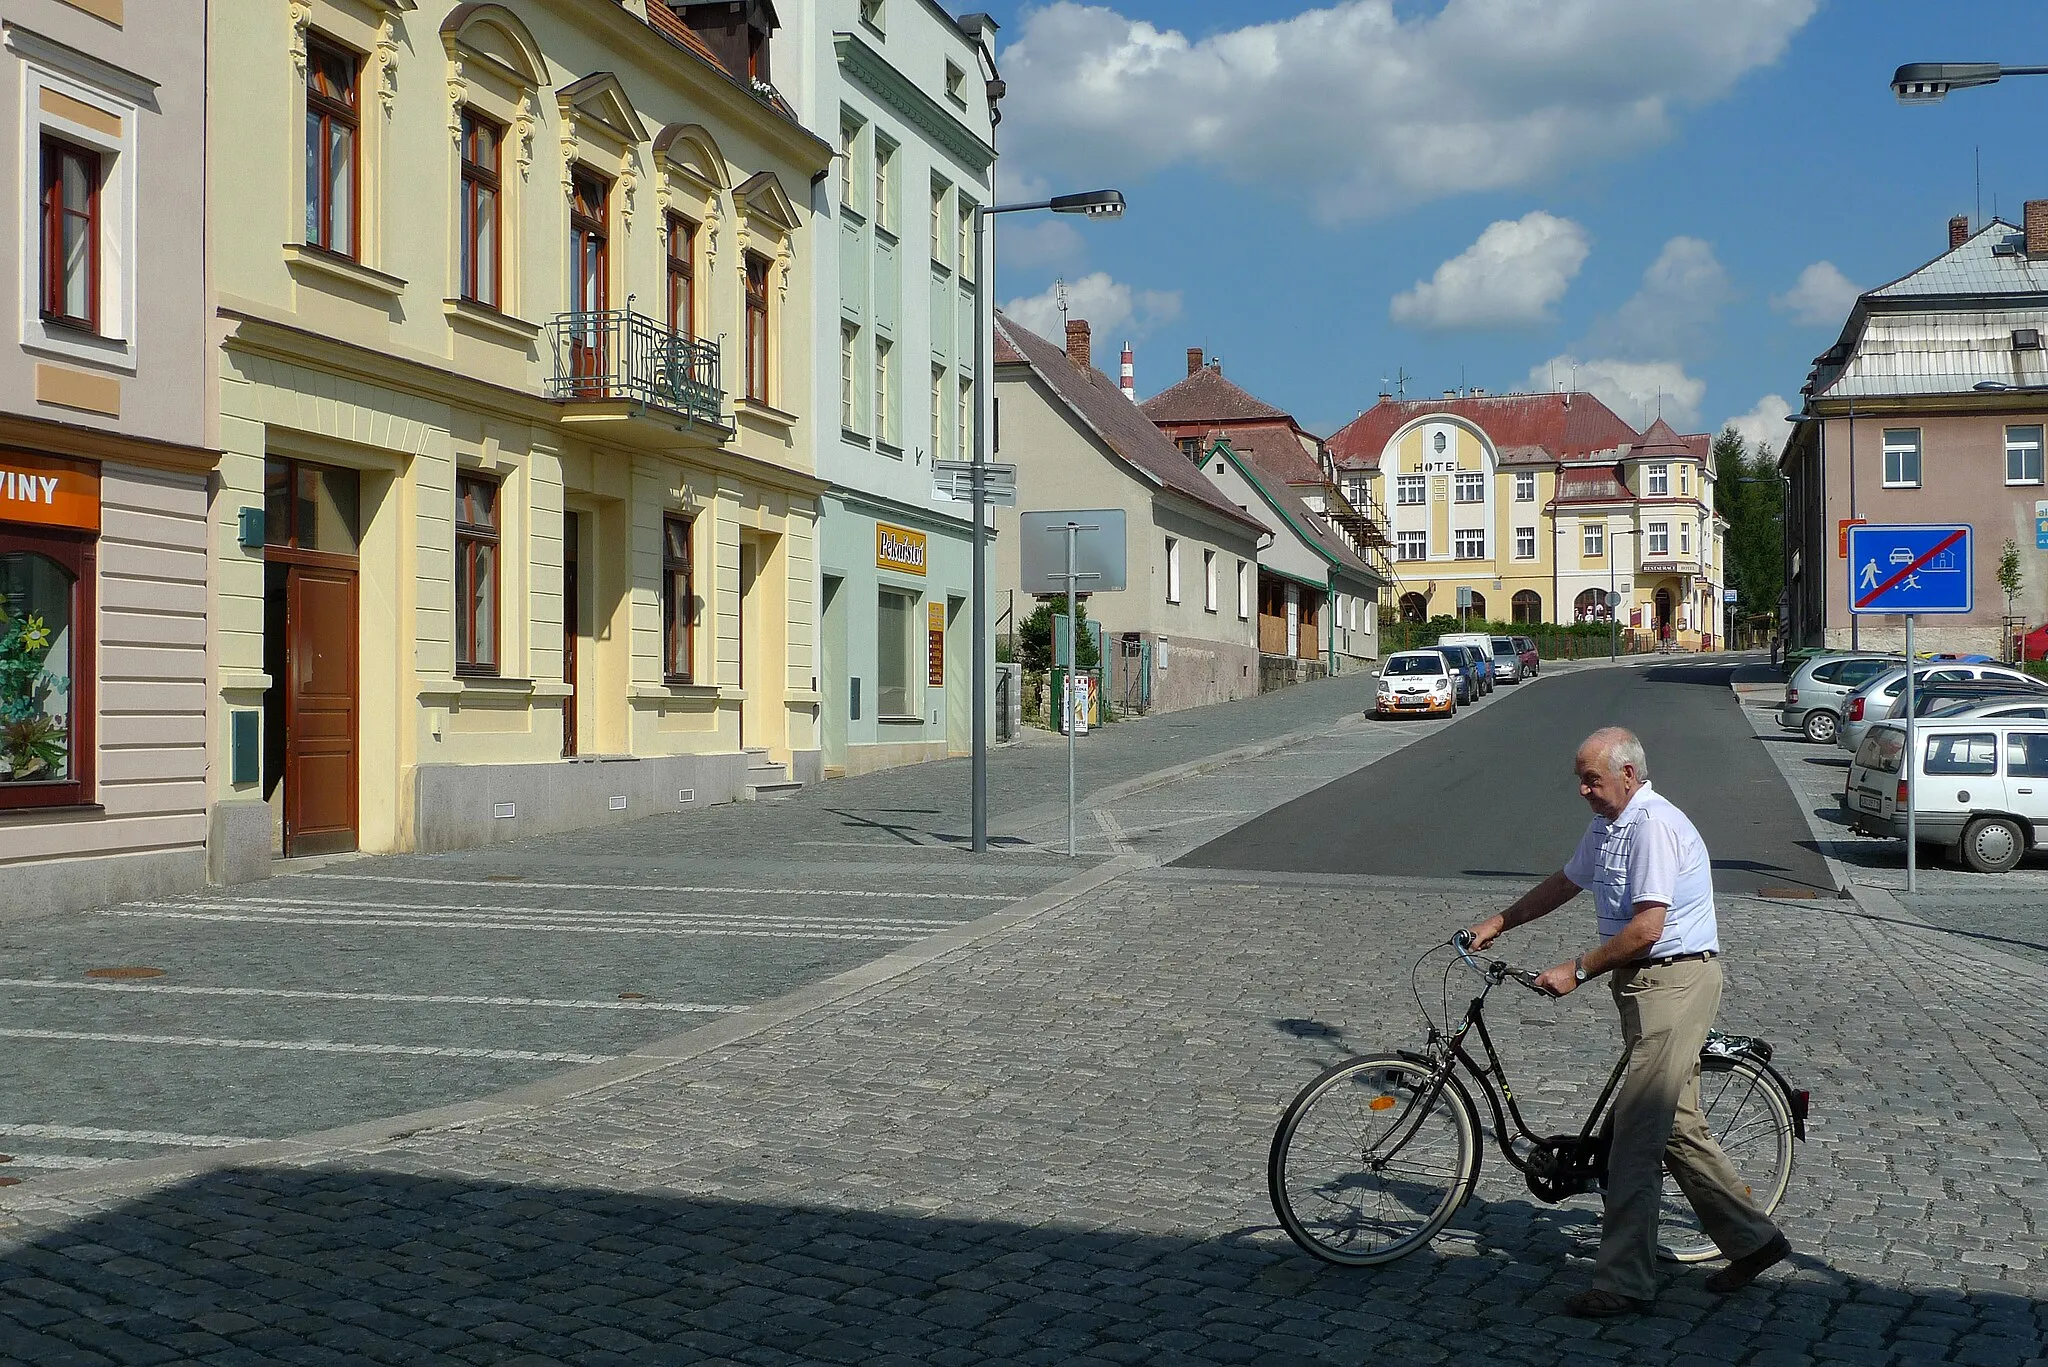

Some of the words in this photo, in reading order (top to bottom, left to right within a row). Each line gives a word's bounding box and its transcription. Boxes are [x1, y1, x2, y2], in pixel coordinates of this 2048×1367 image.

[1413, 461, 1467, 473] HOTEL
[0, 471, 59, 505] INY
[879, 530, 924, 567] Pekařství
